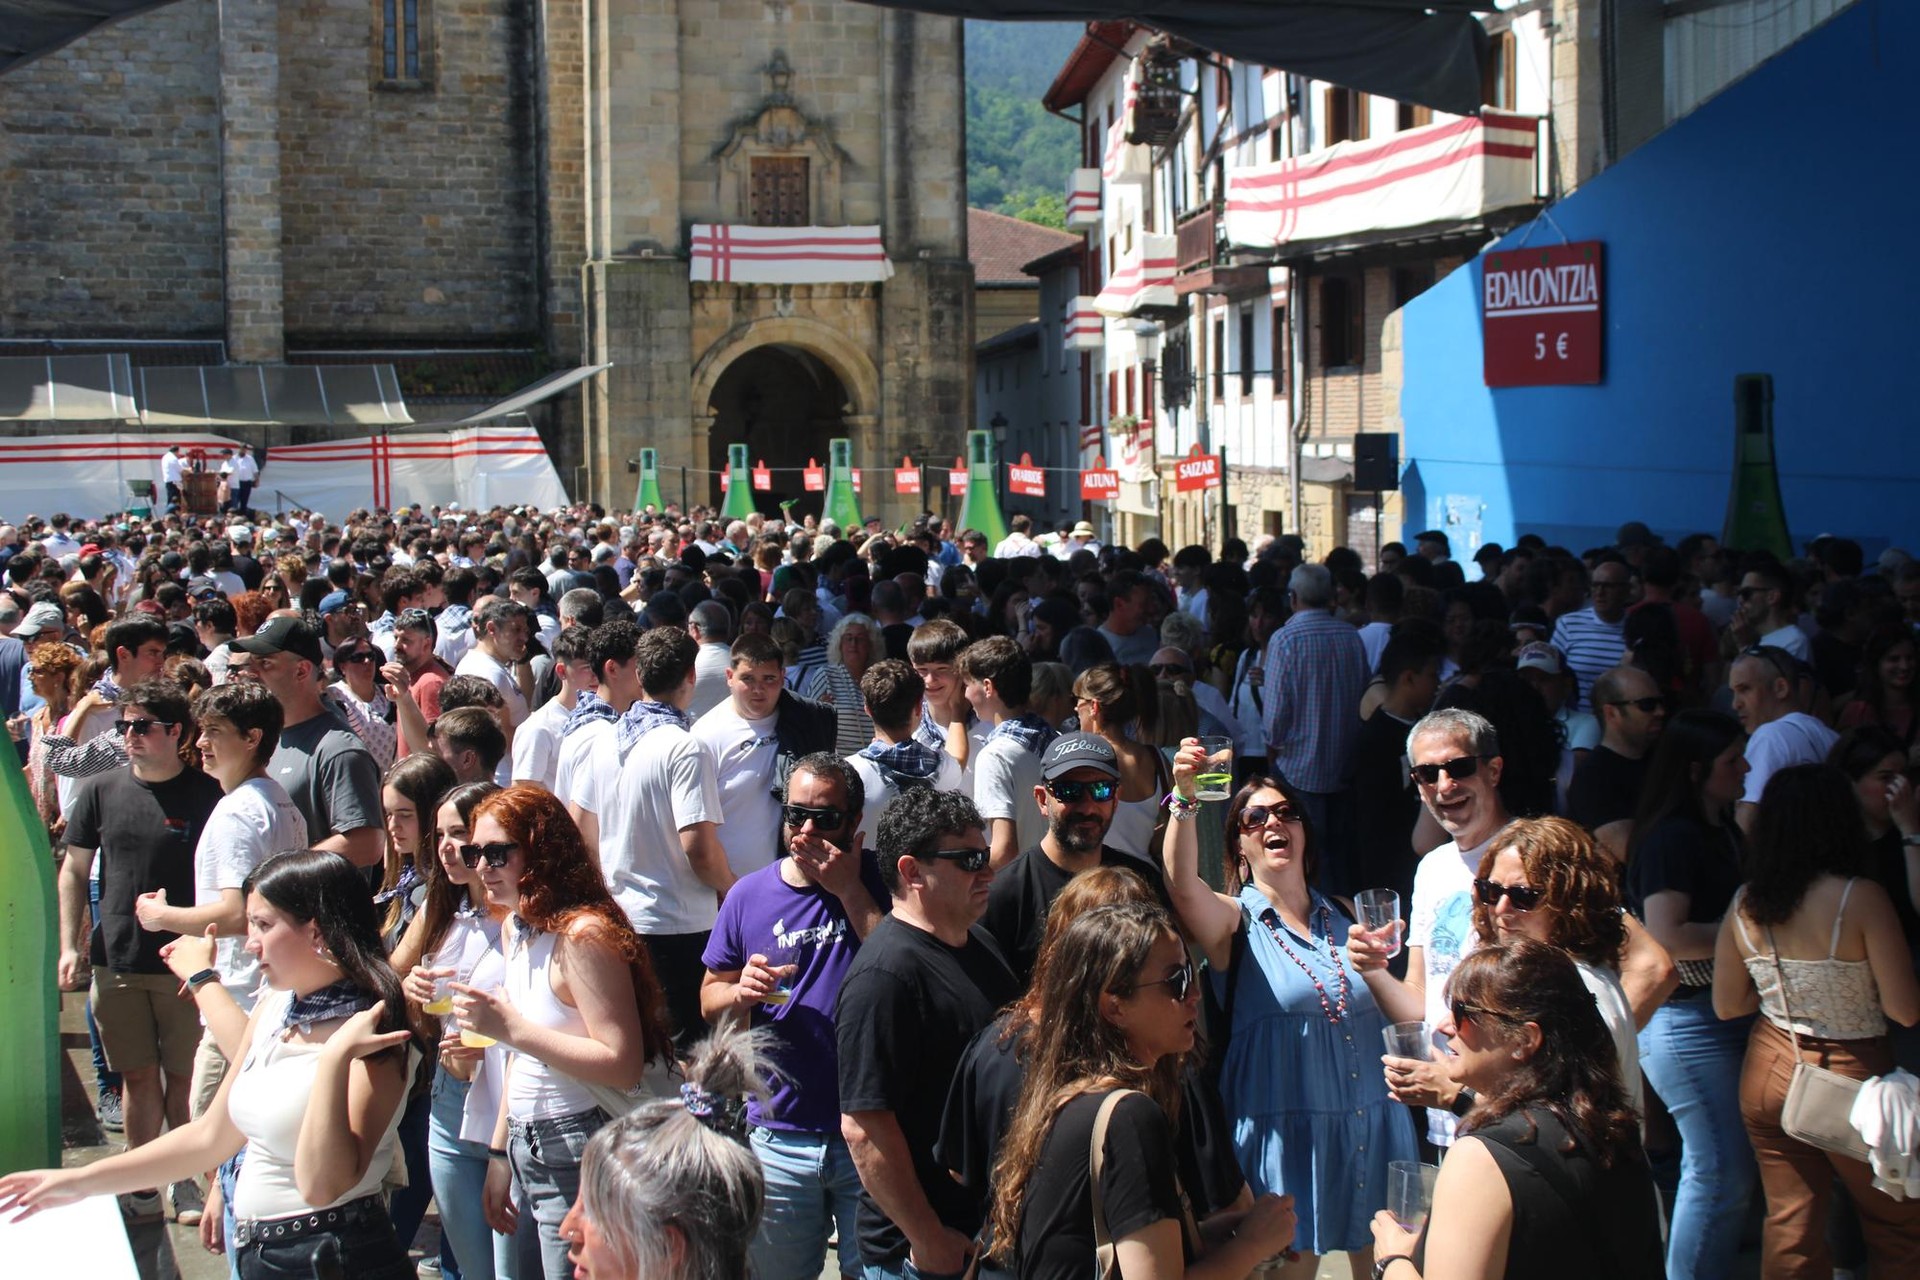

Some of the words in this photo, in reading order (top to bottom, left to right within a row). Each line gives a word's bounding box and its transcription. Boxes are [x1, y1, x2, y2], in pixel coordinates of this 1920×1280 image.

[1485, 263, 1598, 309] EDALONTZIA
[1535, 332, 1545, 360] 5
[1556, 332, 1569, 360] €
[1084, 472, 1117, 488] ALTUNA
[1180, 459, 1215, 479] SAIZAR
[1051, 738, 1111, 761] Titleist
